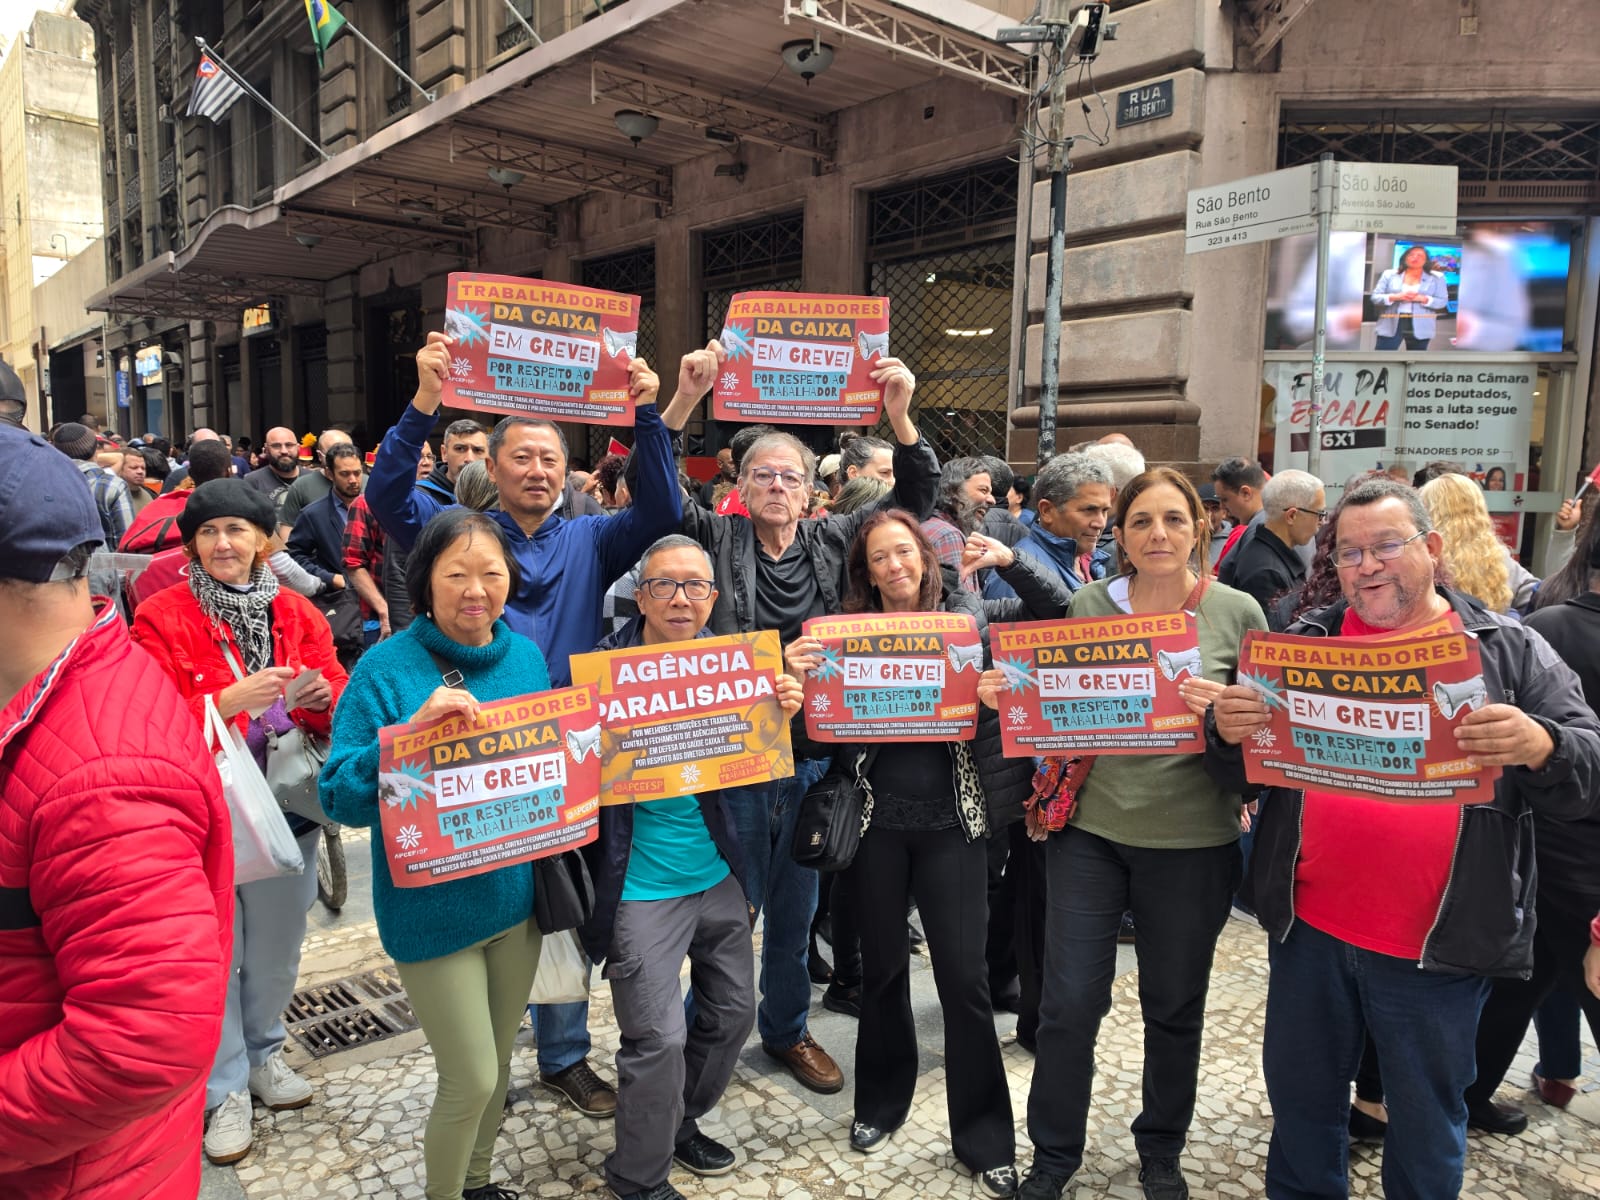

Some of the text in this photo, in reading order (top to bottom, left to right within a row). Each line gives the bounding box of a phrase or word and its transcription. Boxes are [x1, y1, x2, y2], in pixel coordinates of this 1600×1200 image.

[1130, 87, 1160, 104] RUA
[1142, 99, 1166, 116] BENTO
[1342, 174, 1407, 192] São João
[1197, 184, 1270, 214] São Bento
[1377, 200, 1392, 208] São
[1395, 200, 1415, 209] João
[1214, 216, 1230, 226] São
[1233, 211, 1258, 222] Bento
[1208, 236, 1222, 245] 323
[1232, 232, 1247, 240] 413
[461, 285, 628, 312] TRABALHADORES
[734, 302, 880, 314] TRABALHADORES
[494, 304, 596, 332] DA CAIXA
[757, 320, 852, 337] DA CAIXA
[494, 331, 595, 363] EM GREVE!
[758, 344, 849, 367] EM GREVE!
[490, 362, 590, 381] POR RESPEITO AO
[755, 374, 844, 384] POR RESPEITO AO
[1409, 373, 1452, 383] Vitória
[1477, 374, 1529, 383] Câmara
[498, 376, 581, 393] TRABALHADOR
[762, 387, 838, 396] TRABALHADOR
[1292, 368, 1389, 399] FM DA
[1407, 389, 1511, 401] dos Deputados,
[1448, 404, 1473, 414] luta
[1478, 406, 1517, 416] segue
[1425, 420, 1479, 429] Senado!
[1322, 432, 1355, 446] 6X1
[1395, 447, 1457, 455] SENADORES
[816, 619, 967, 635] TRABALHADORES
[1003, 618, 1182, 646] TRABALHADORES
[847, 637, 940, 652] DA CAIXA
[1038, 644, 1149, 664] DA CAIXA
[1254, 641, 1461, 667] TRABALHADORES
[617, 651, 750, 685] AGÊNCIA
[849, 663, 941, 681] EM GREVE!
[1044, 673, 1151, 690] EM GREVE!
[1286, 669, 1423, 693] DA CAIXA
[847, 689, 938, 703] POR RESPEITO AO
[856, 701, 932, 714] TRABALHADOR
[1044, 698, 1148, 715] POR RESPEITO AO
[1294, 699, 1424, 731] EM GREVE!
[400, 693, 587, 752] TRABALHADORES
[632, 729, 643, 738] POR
[644, 725, 672, 735] MELHORES
[673, 720, 702, 731] CONDIÇÕES
[702, 719, 709, 727] DE
[1054, 712, 1142, 727] TRABALHADOR
[434, 725, 558, 764] DA CAIXA
[622, 740, 643, 749] CONTRA
[649, 733, 683, 744] FECHAMENTO
[693, 727, 718, 737] AGÊNCIAS
[649, 747, 658, 755] EM
[659, 744, 678, 753] DEFESA
[687, 738, 704, 748] SAÚDE
[705, 738, 720, 746] CAIXA
[1296, 731, 1421, 754] POR RESPEITO AO
[635, 759, 646, 767] POR
[647, 754, 672, 765] RESPEITO
[673, 752, 683, 760] AOS
[714, 744, 742, 754] CATEGORIA
[1308, 748, 1412, 769] TRABALHADOR
[441, 760, 561, 797] EM GREVE!
[443, 789, 560, 829] POR RESPEITO AO
[456, 808, 554, 842] TRABALHADOR
